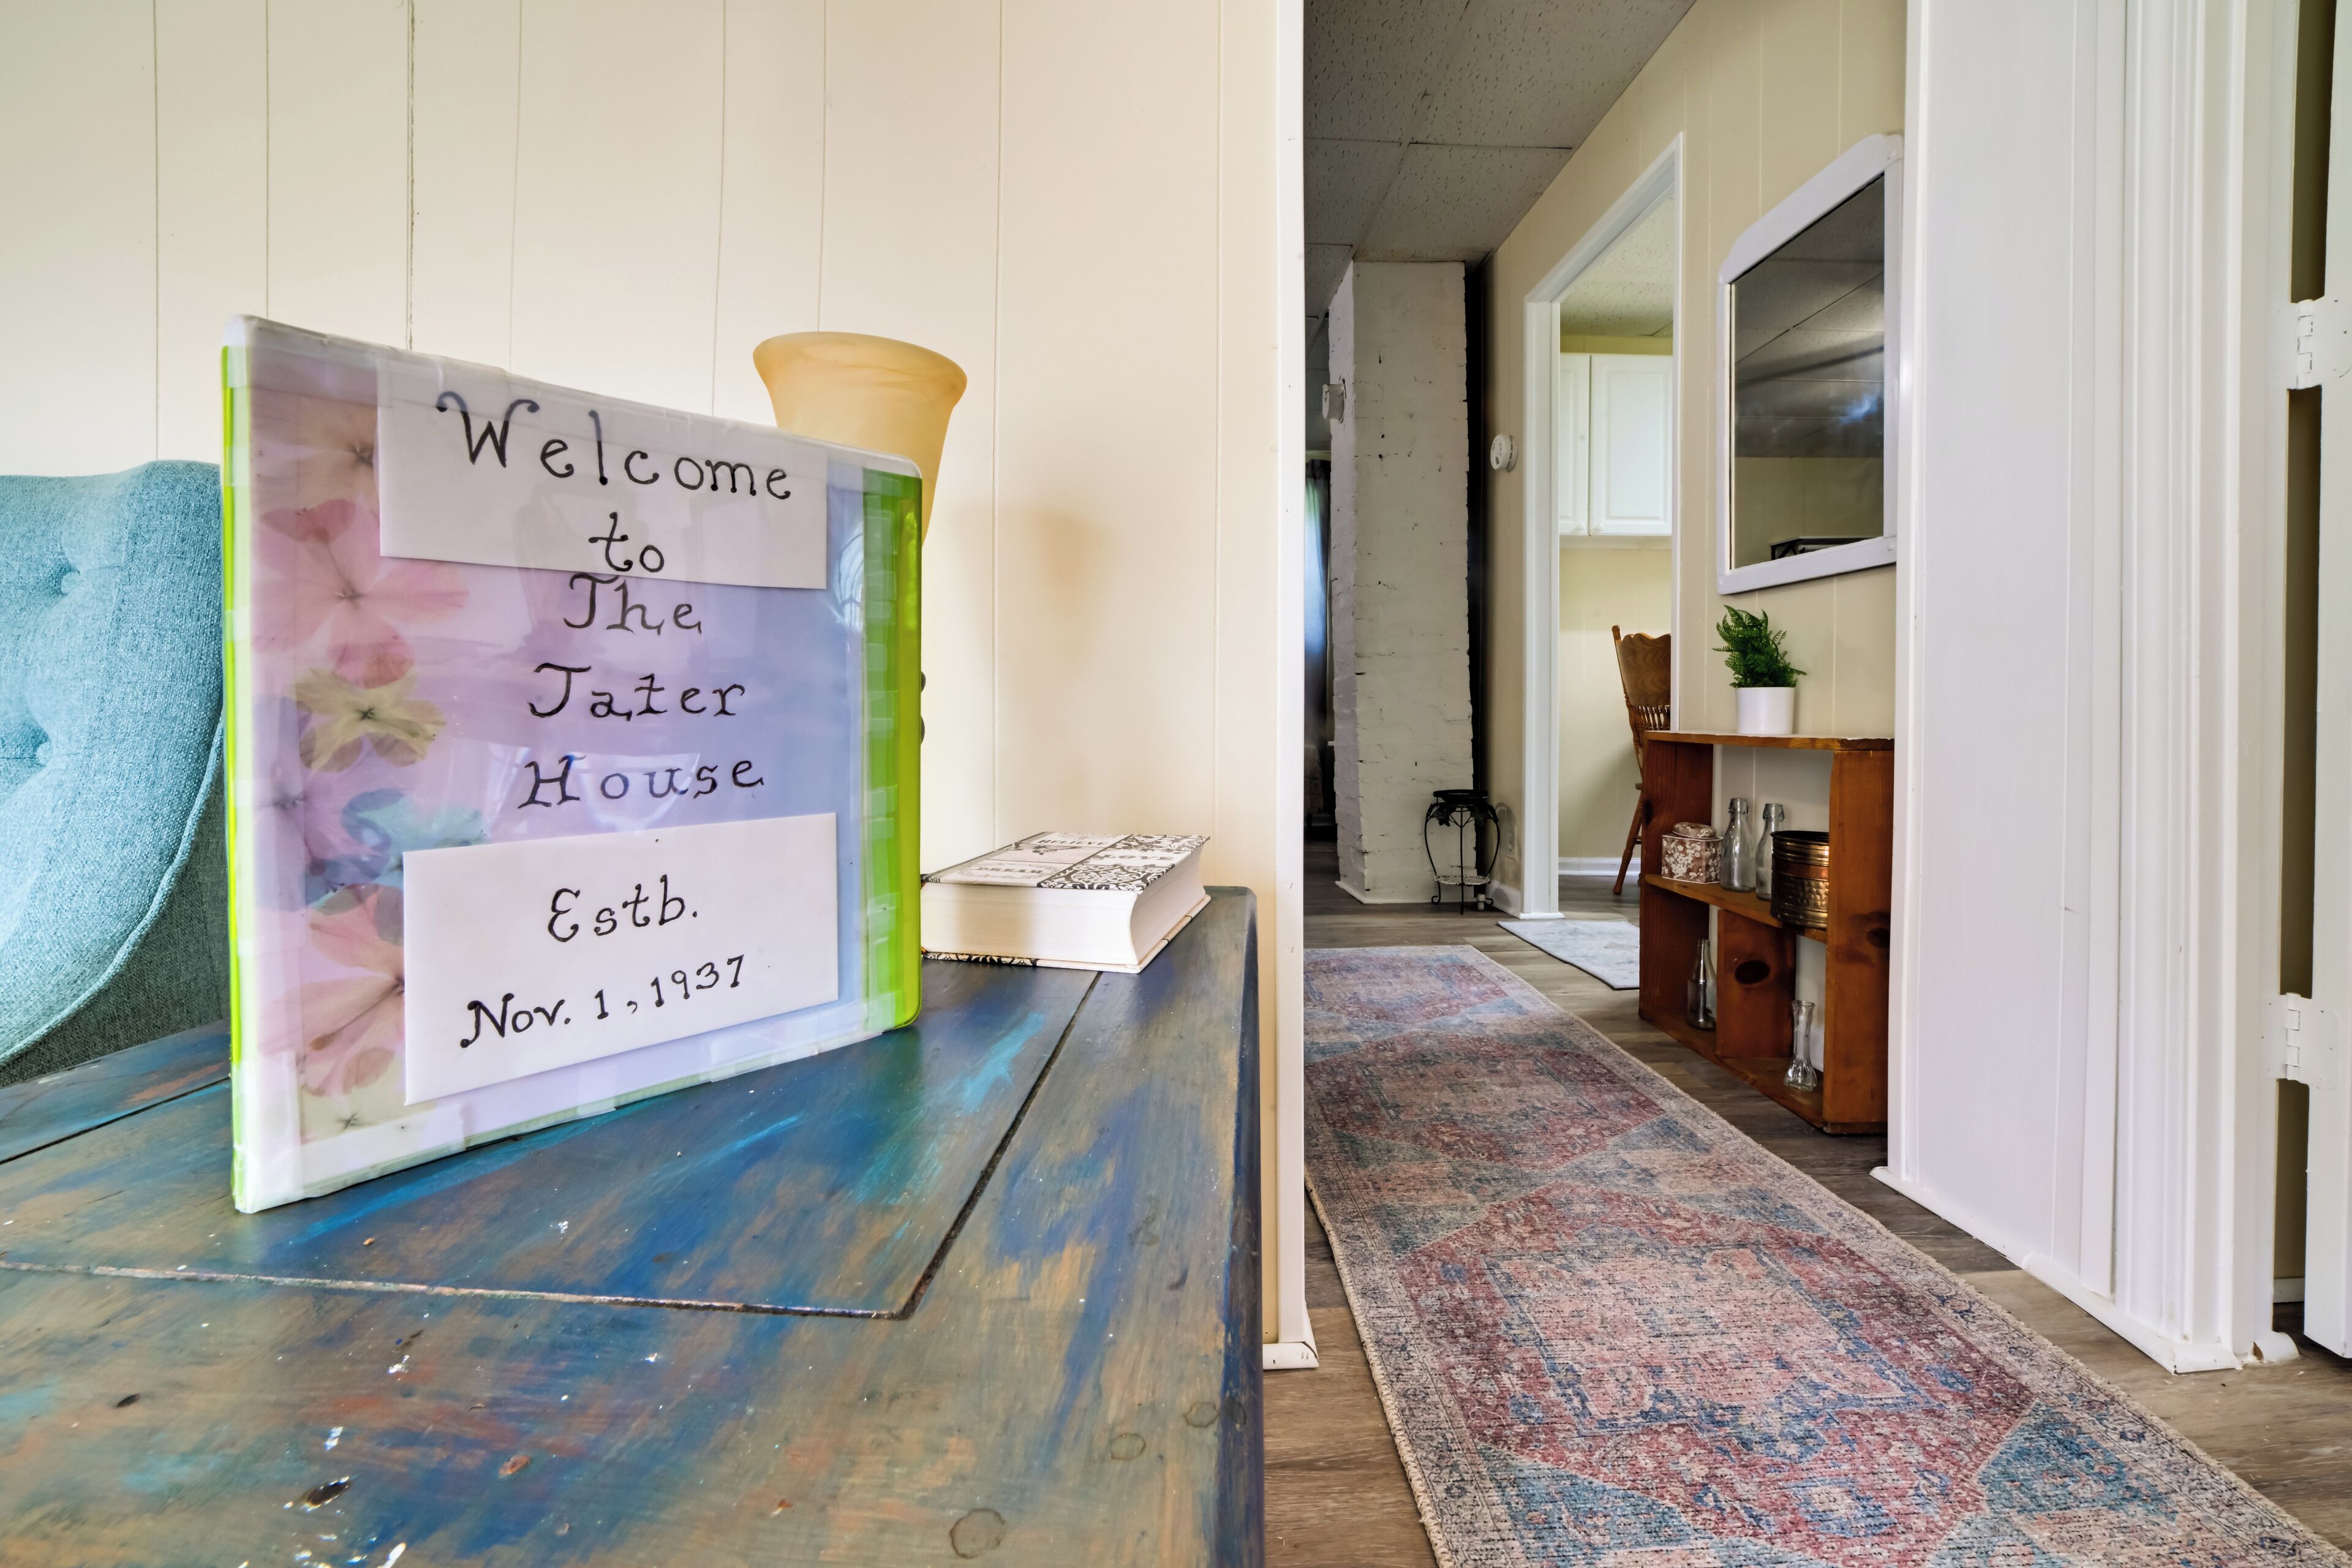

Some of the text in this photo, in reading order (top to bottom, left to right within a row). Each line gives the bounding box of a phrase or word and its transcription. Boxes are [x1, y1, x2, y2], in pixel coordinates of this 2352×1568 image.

[436, 391, 791, 500] Welcome
[588, 511, 665, 573] to
[564, 572, 702, 636] The
[518, 755, 764, 809] House
[548, 874, 698, 943] Estb.
[460, 992, 571, 1049] Nov.
